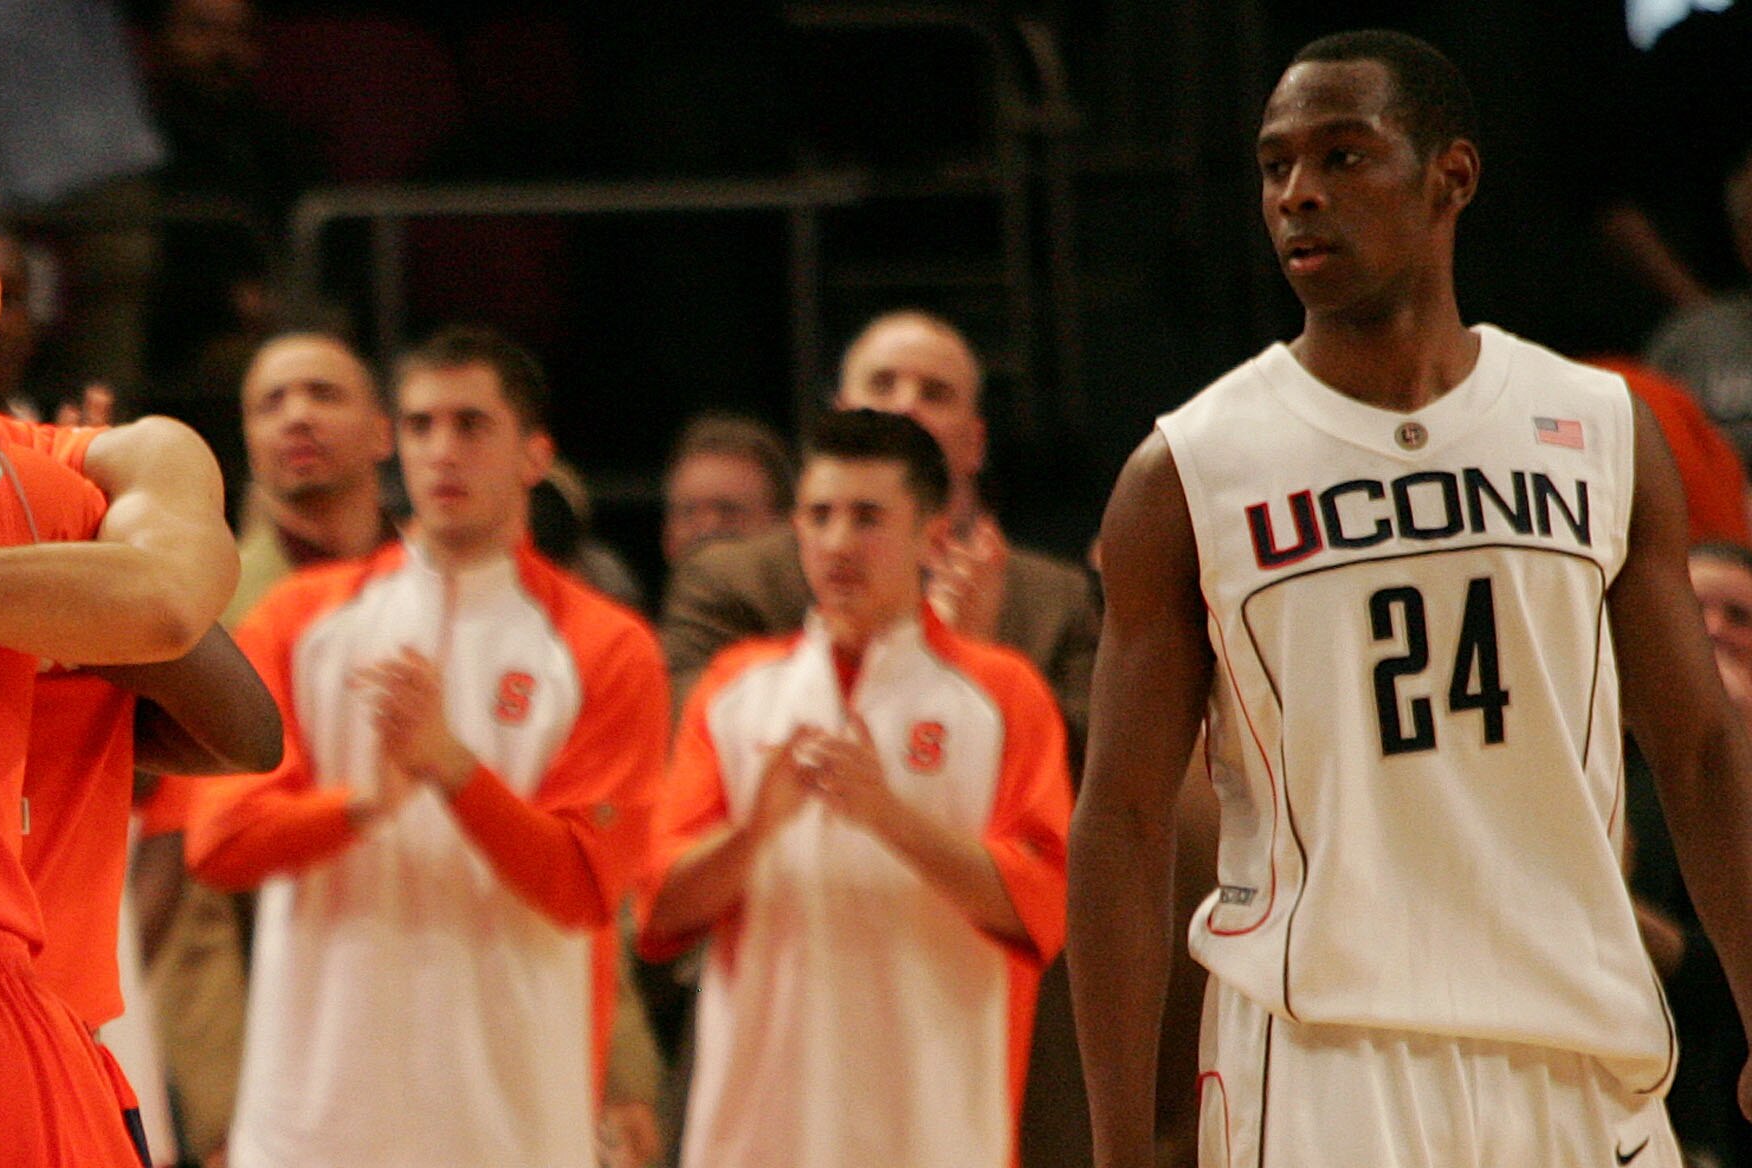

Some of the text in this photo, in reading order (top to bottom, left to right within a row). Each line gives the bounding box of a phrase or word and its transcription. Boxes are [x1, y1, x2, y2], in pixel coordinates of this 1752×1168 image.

[1245, 467, 1592, 570] UCONN
[495, 671, 535, 724] S
[1368, 577, 1510, 757] 24
[905, 721, 947, 774] S
